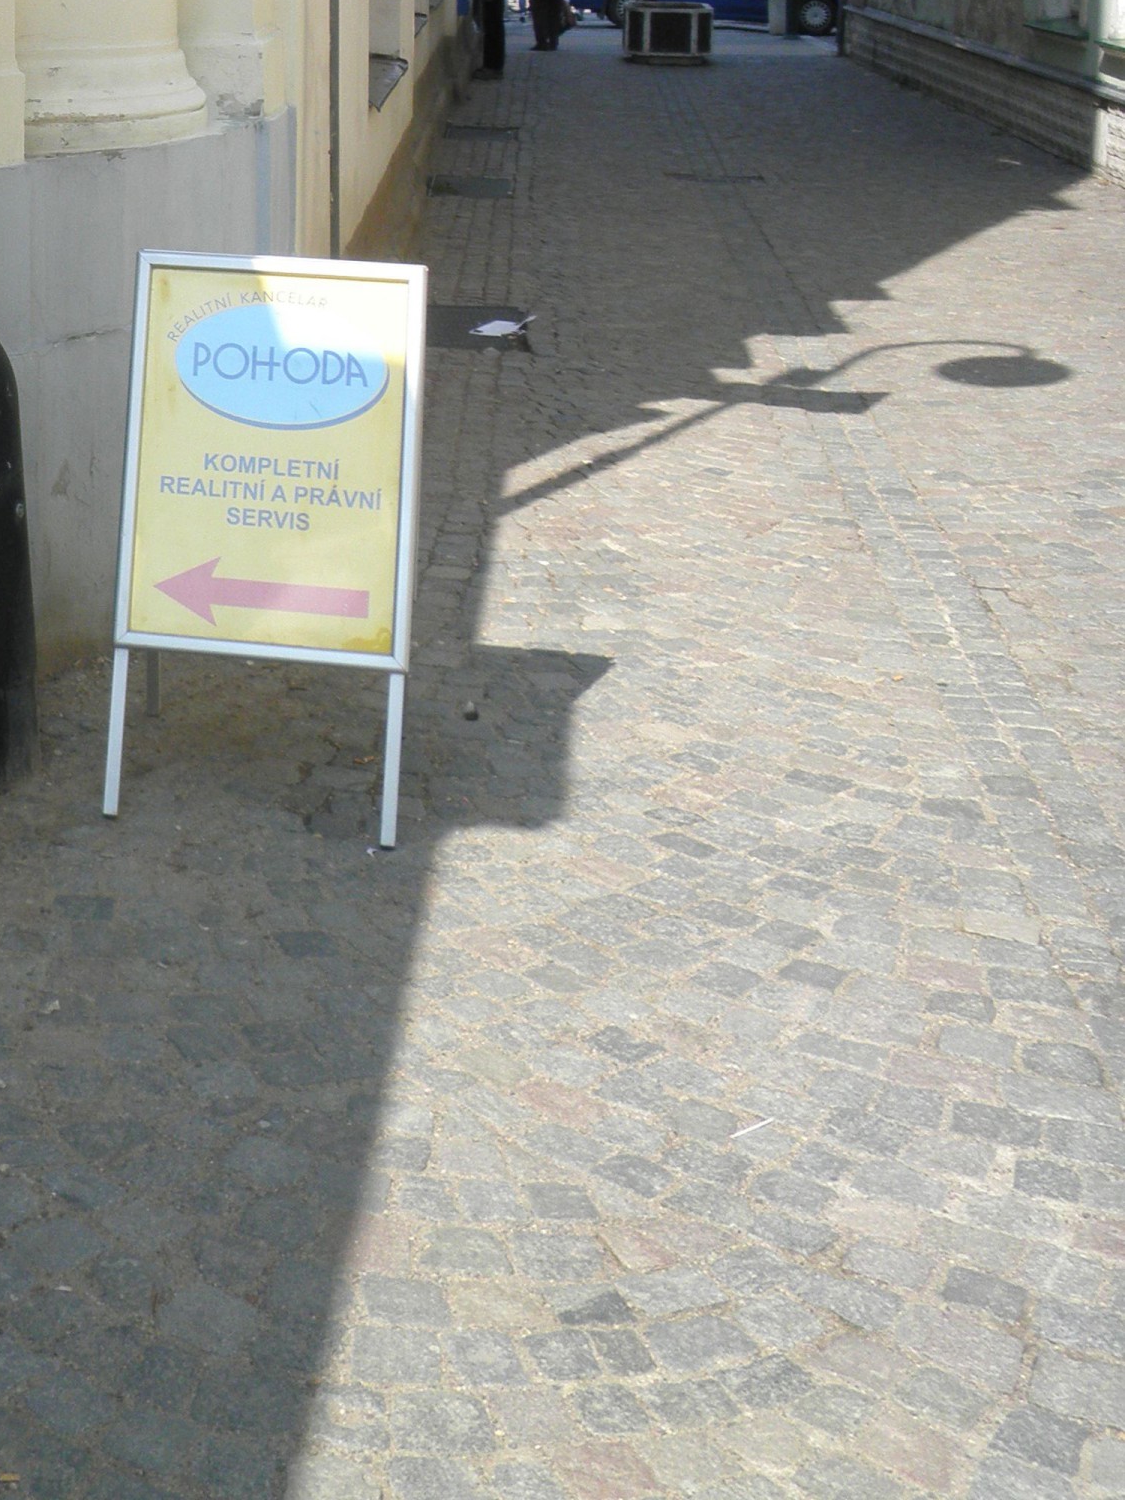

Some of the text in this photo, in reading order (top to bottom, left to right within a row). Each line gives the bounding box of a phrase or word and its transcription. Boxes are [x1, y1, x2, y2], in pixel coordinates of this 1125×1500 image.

[166, 292, 232, 342] REALITNÍ
[192, 342, 369, 387] POHODA
[203, 453, 340, 480] KOMPLETNÍ
[160, 476, 382, 511] REALITNÍ A PRÁVNÍ
[226, 507, 310, 531] SERVIS
